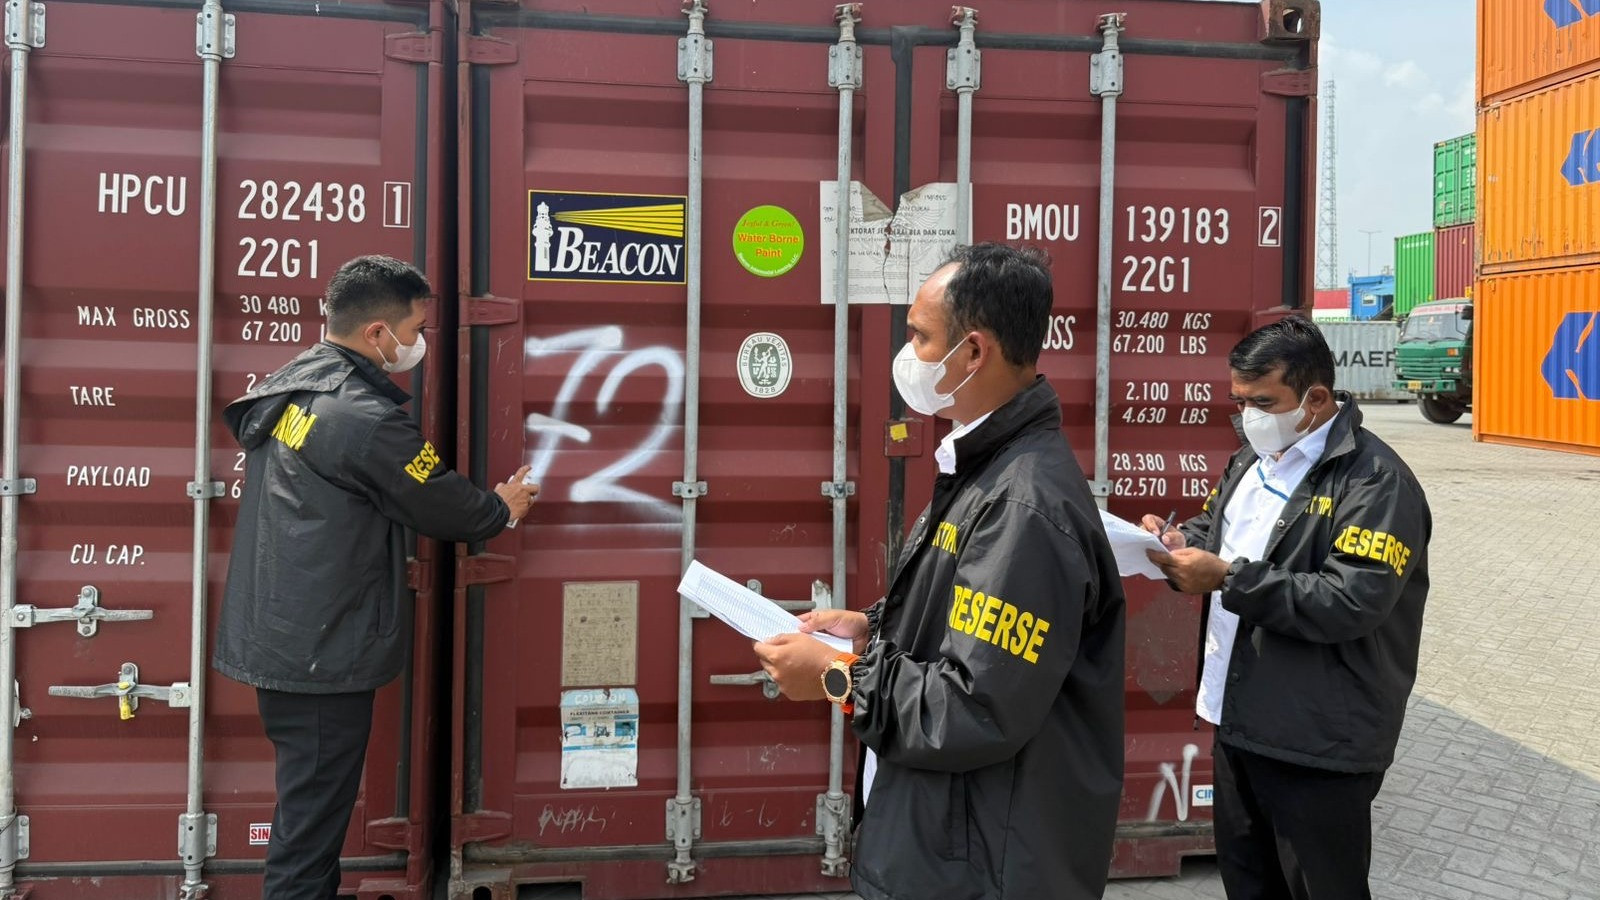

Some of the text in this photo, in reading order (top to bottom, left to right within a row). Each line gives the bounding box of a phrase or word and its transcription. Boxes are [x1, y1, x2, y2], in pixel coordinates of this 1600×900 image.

[98, 173, 402, 225] HPCU 282438 1
[1006, 203, 1277, 246] BMOU 139183 2
[738, 232, 799, 244] Water Borne
[238, 237, 318, 279] 22G1
[756, 248, 782, 258] Paint
[1121, 256, 1191, 293] 22G1
[240, 295, 261, 314] 30
[268, 296, 300, 315] 480
[78, 305, 190, 329] MAX GROSS
[1182, 313, 1212, 330] KGS
[241, 321, 262, 341] 67
[269, 322, 301, 342] 200
[1180, 336, 1207, 354] LBS
[70, 386, 116, 407] TARE
[754, 386, 776, 394] 1828
[1126, 382, 1212, 401] 2.100 KGS
[1122, 407, 1209, 424] 4.630 LBS
[1112, 453, 1208, 471] 28.380 KGS
[66, 466, 151, 488] PAYLOAD
[1114, 478, 1210, 497] 62.570 LBS
[71, 544, 145, 565] CU. CAP.
[1334, 525, 1412, 577] RESERSE
[949, 585, 1050, 664] RESERSE
[251, 828, 269, 840] SIN
